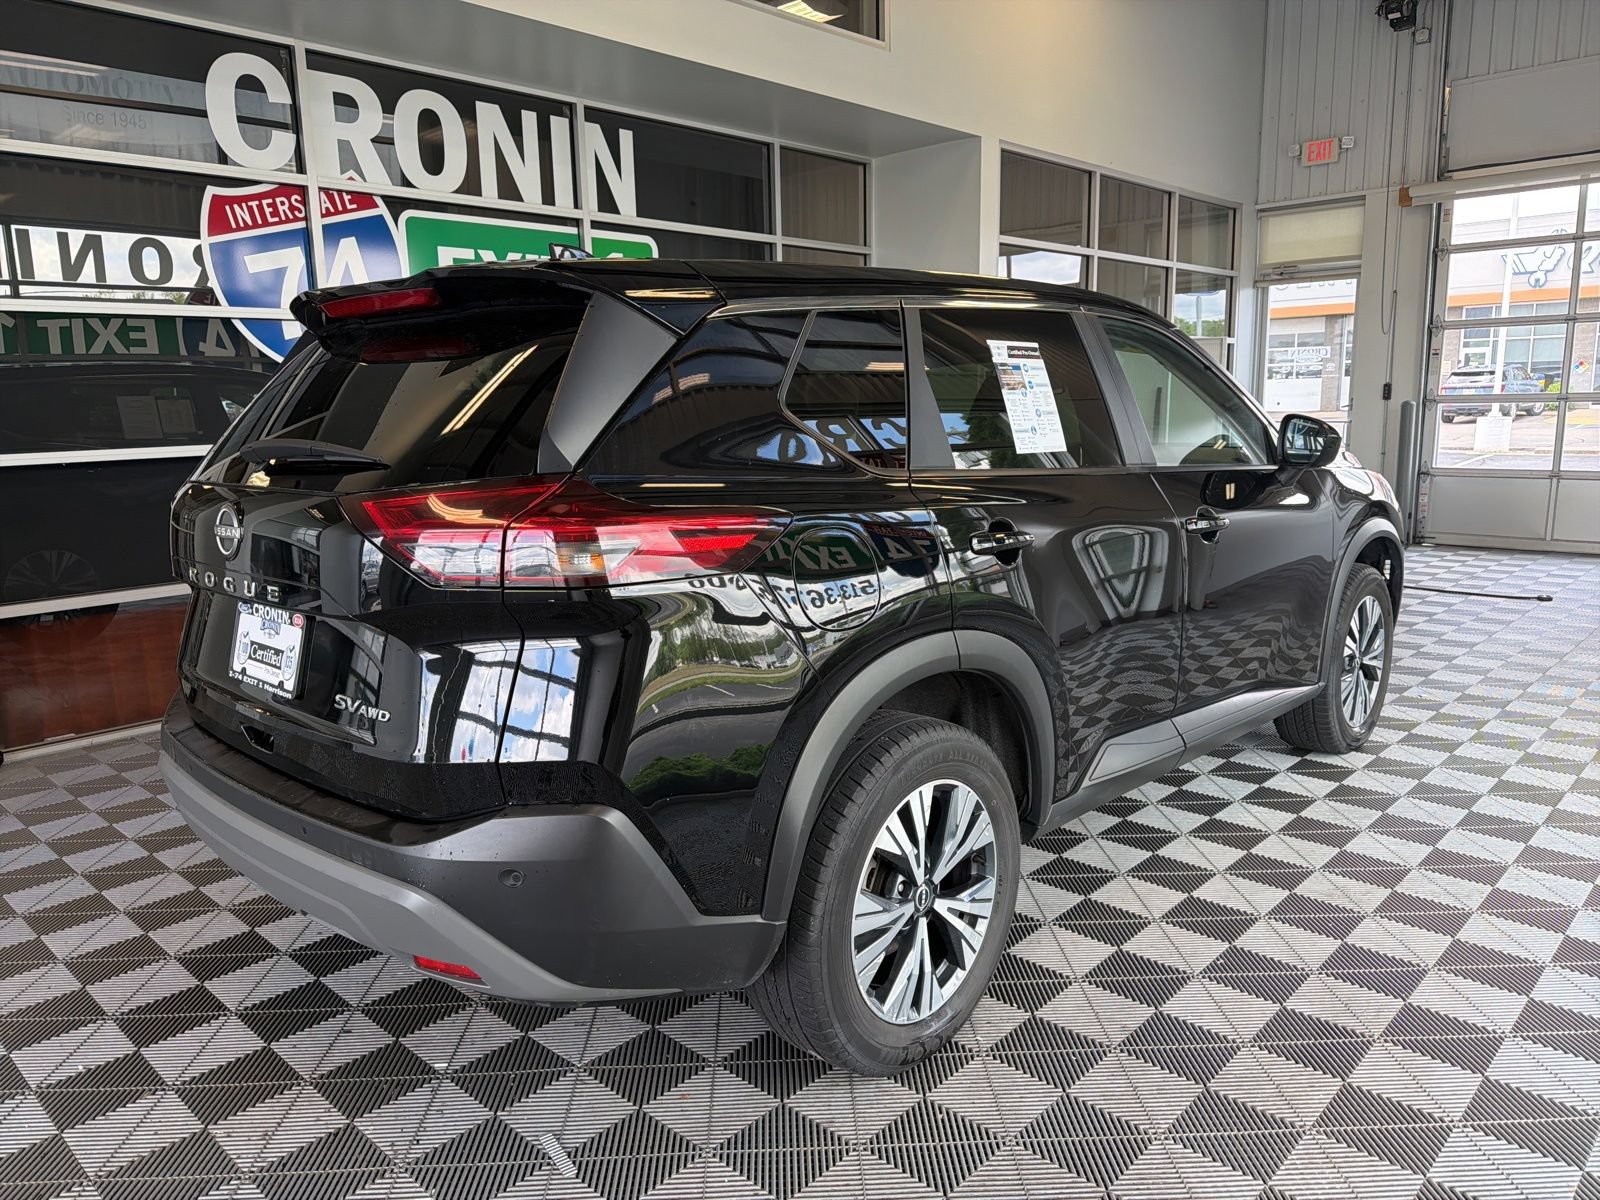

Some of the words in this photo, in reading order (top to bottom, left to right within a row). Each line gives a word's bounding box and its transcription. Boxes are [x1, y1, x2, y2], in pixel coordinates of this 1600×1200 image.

[62, 105, 105, 126] Since
[111, 111, 147, 130] 1945
[205, 52, 637, 217] CRONIN
[1307, 138, 1334, 162] EXIT
[225, 190, 358, 229] INTERSATE
[189, 566, 280, 602] ROGUE
[250, 643, 282, 667] Certified
[243, 675, 258, 686] EXIT
[263, 683, 292, 699] Harrison
[334, 694, 361, 713] SV
[357, 705, 390, 722] AWD
